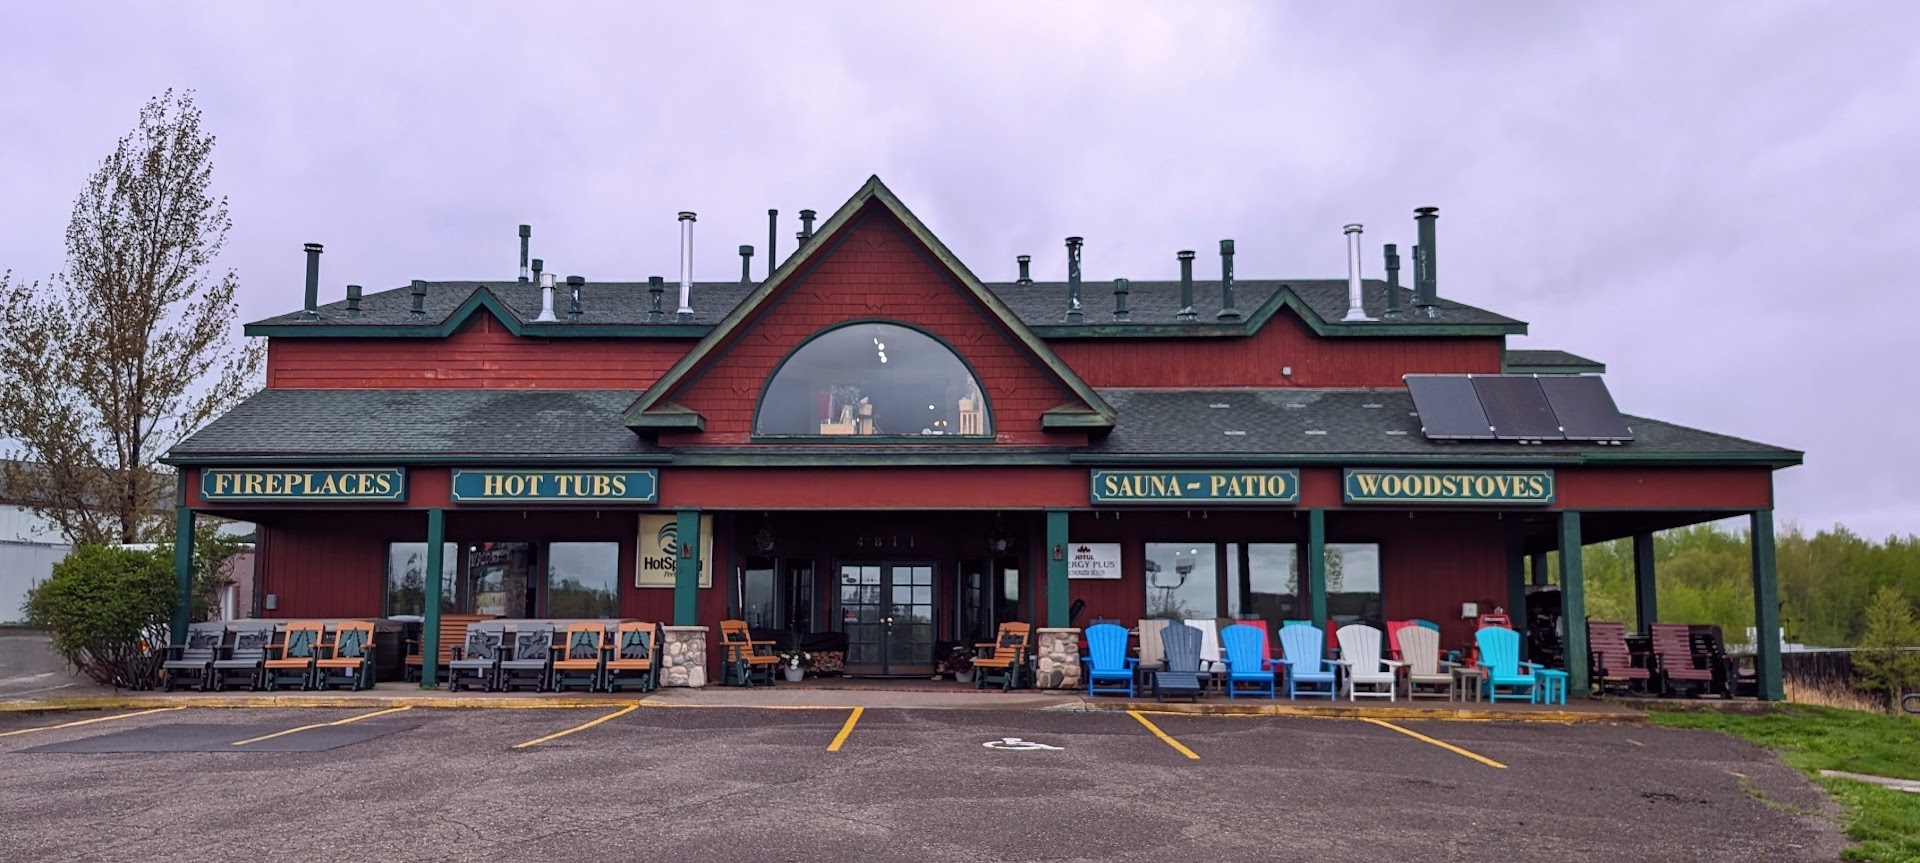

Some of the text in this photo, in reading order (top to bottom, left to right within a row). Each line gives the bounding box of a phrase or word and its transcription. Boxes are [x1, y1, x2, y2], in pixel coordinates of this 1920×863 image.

[214, 473, 391, 495] FIREPLACES
[483, 475, 627, 496] HOT TUBS
[1105, 475, 1182, 497] SAUNA
[1209, 475, 1286, 497] PATIO
[1356, 474, 1544, 497] WOODSTOVES
[856, 535, 914, 547] 4811
[1068, 560, 1116, 568] ERGY PLUS
